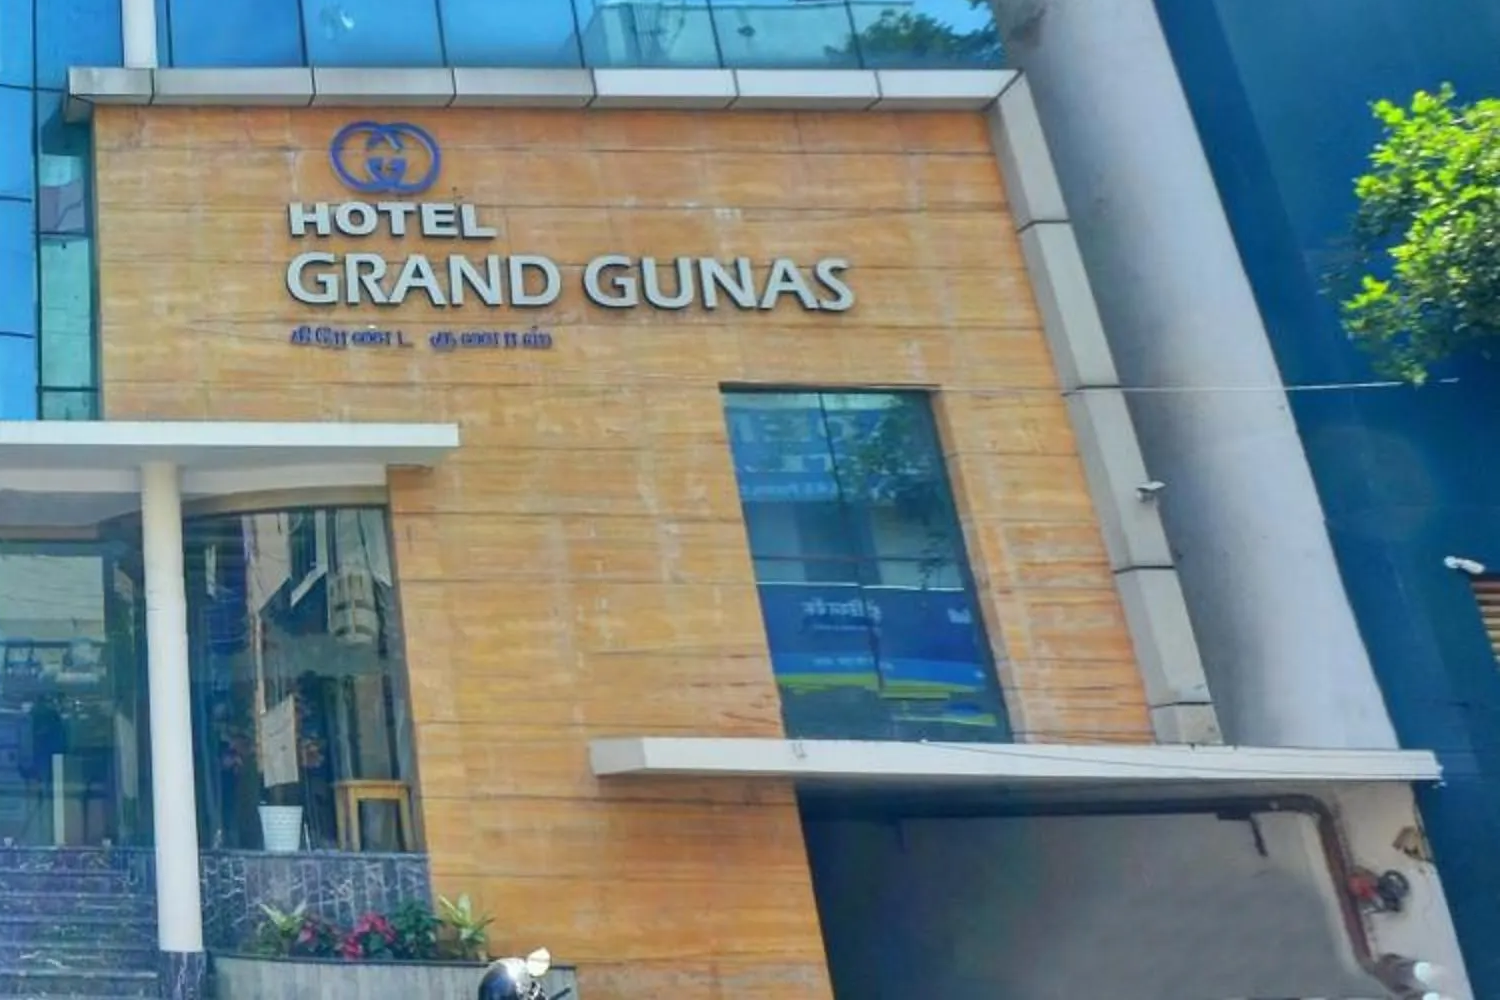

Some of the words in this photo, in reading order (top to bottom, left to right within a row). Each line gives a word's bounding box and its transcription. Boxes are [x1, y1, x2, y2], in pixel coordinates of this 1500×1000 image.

[288, 201, 497, 238] HOTEL
[286, 252, 561, 307] GRAND
[583, 255, 855, 311] GUNAS
